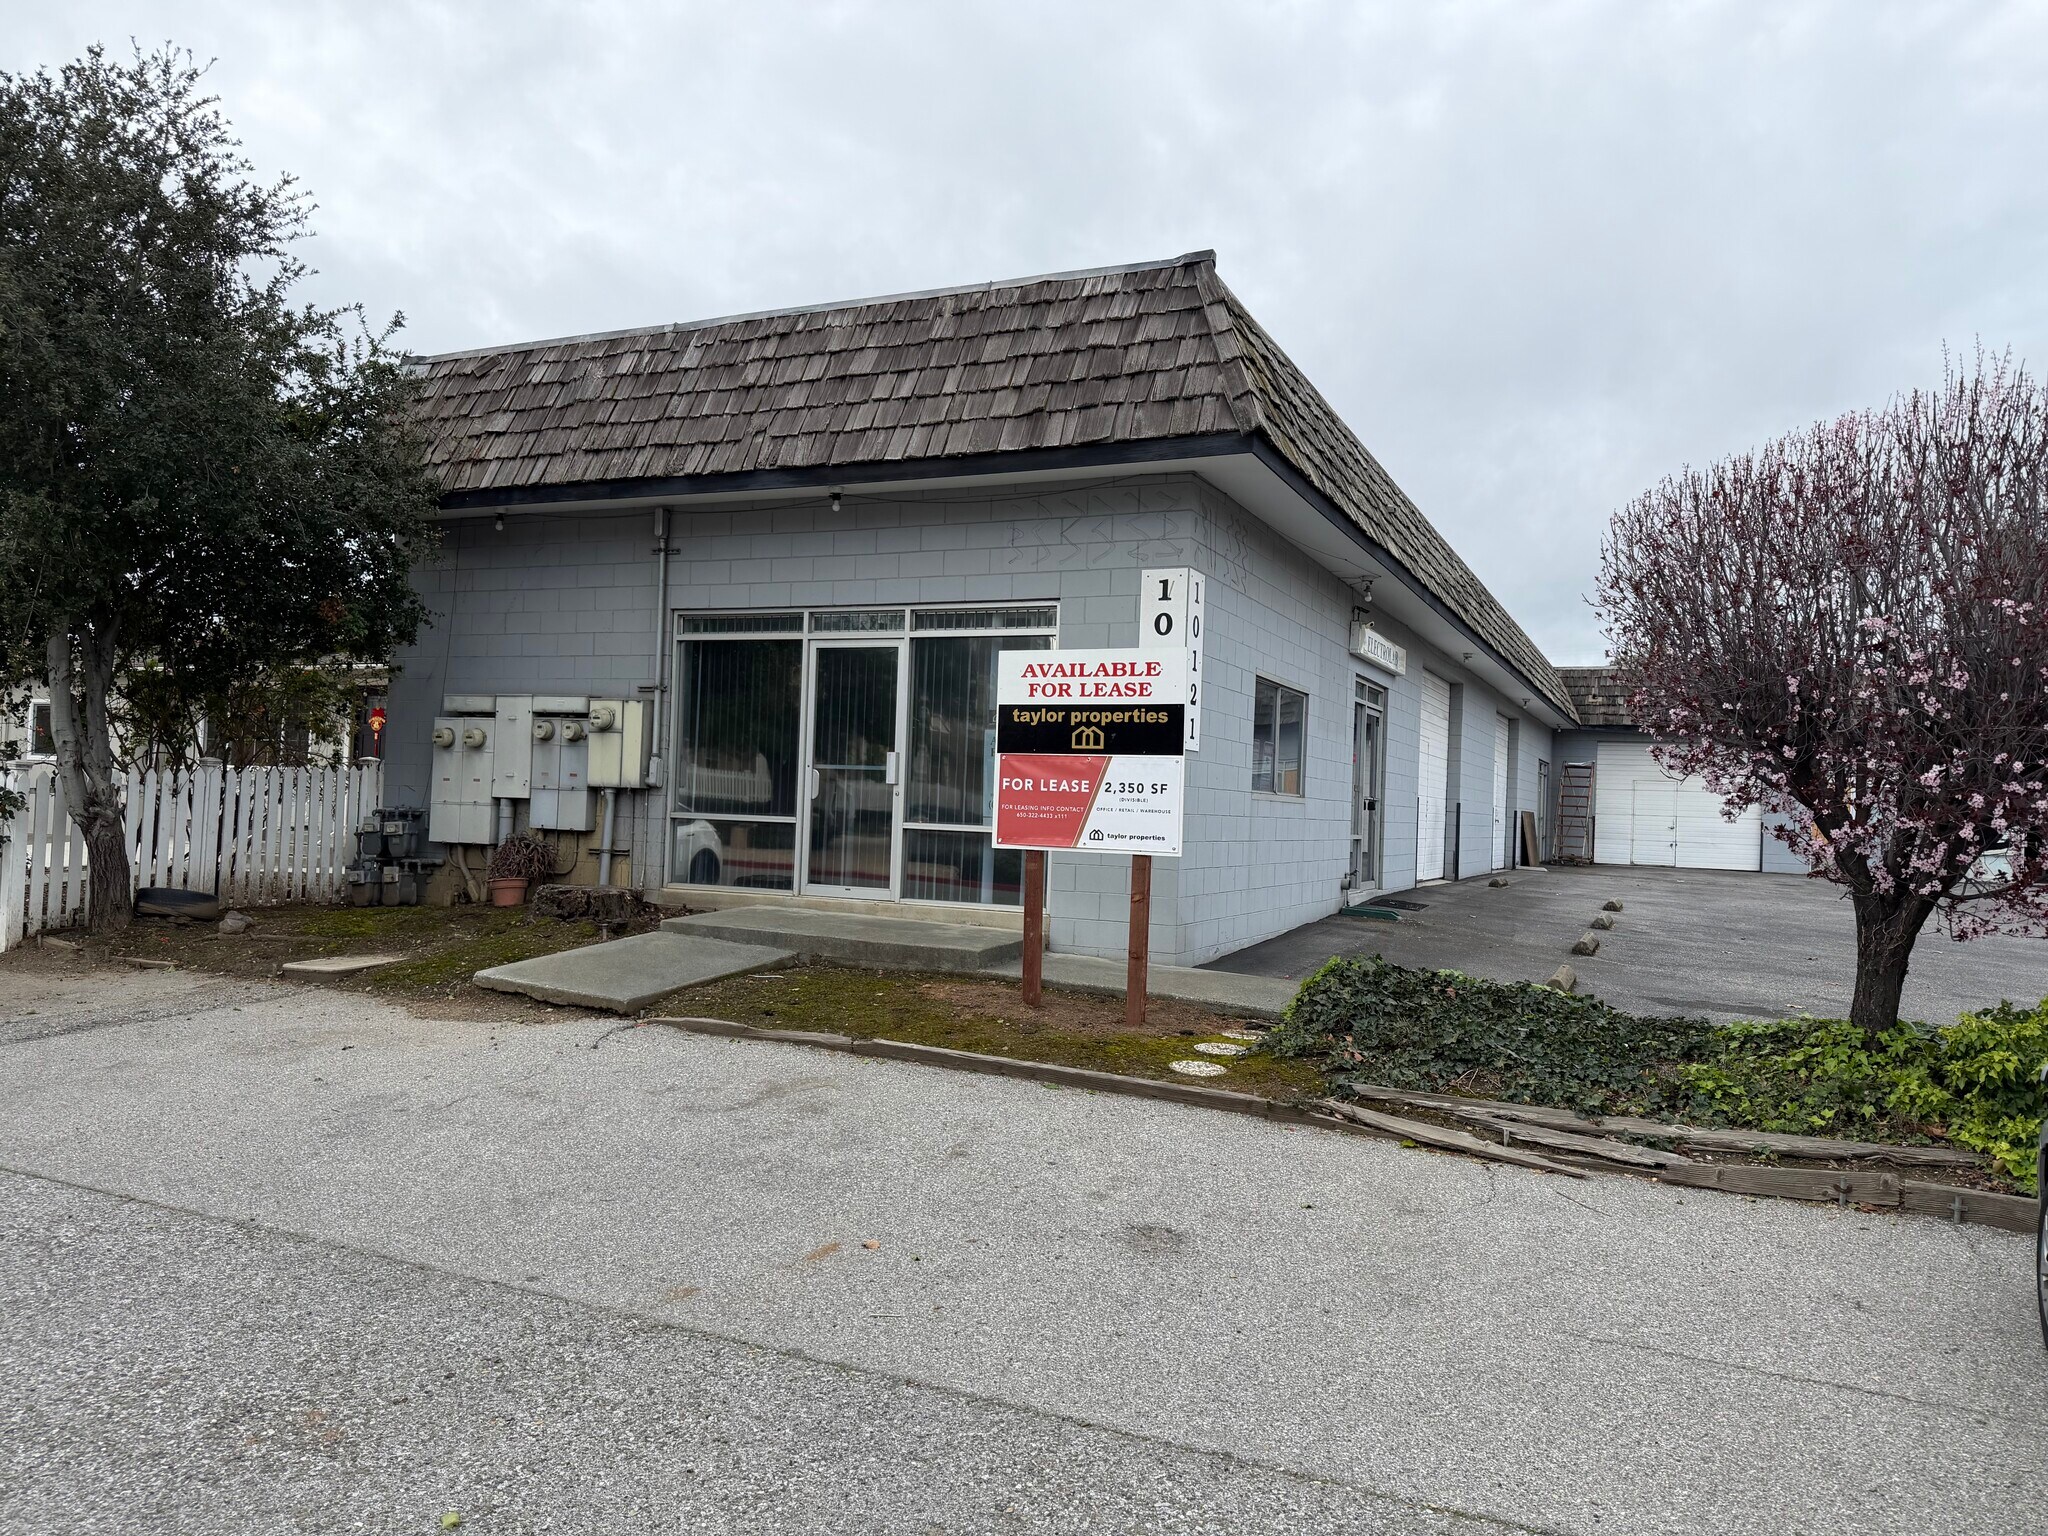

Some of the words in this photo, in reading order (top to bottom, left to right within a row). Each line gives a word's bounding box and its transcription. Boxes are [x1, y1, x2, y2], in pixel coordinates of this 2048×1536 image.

[1190, 582, 1200, 739] 10121
[1021, 661, 1162, 678] AVAILABLE
[1028, 682, 1073, 698] FOR
[1079, 682, 1153, 697] LEASE
[1013, 708, 1066, 726] taylor
[1070, 708, 1168, 726] properties
[1002, 778, 1034, 791] FOR
[1040, 779, 1090, 793] LEASE
[1104, 782, 1145, 795] 2,350
[1150, 783, 1168, 794] SF
[1107, 832, 1128, 841] taylor
[1129, 833, 1166, 843] properties
